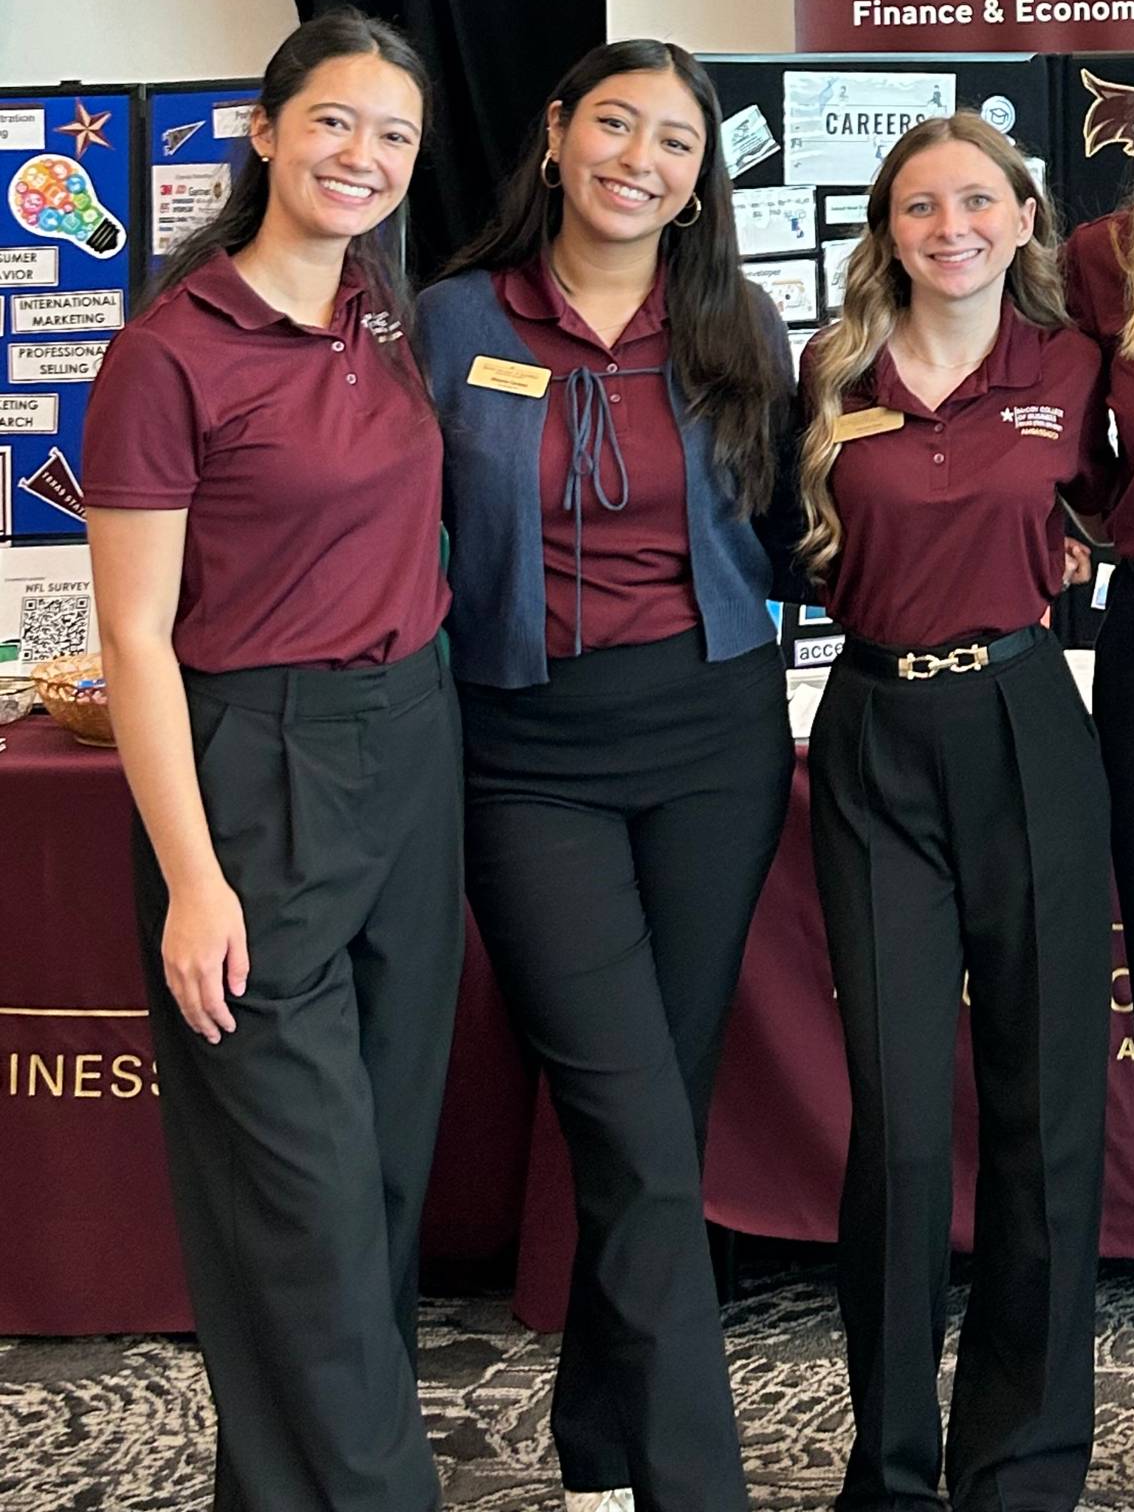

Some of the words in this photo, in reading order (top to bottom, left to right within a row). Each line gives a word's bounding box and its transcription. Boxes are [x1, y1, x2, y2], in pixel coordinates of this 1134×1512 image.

[19, 295, 117, 311] INTERNATIONAL
[32, 313, 105, 327] MARKETING
[18, 346, 107, 359] PROFESSIONA
[40, 363, 89, 375] SELLING
[25, 583, 46, 593] NFL
[48, 581, 90, 592] SURVEY
